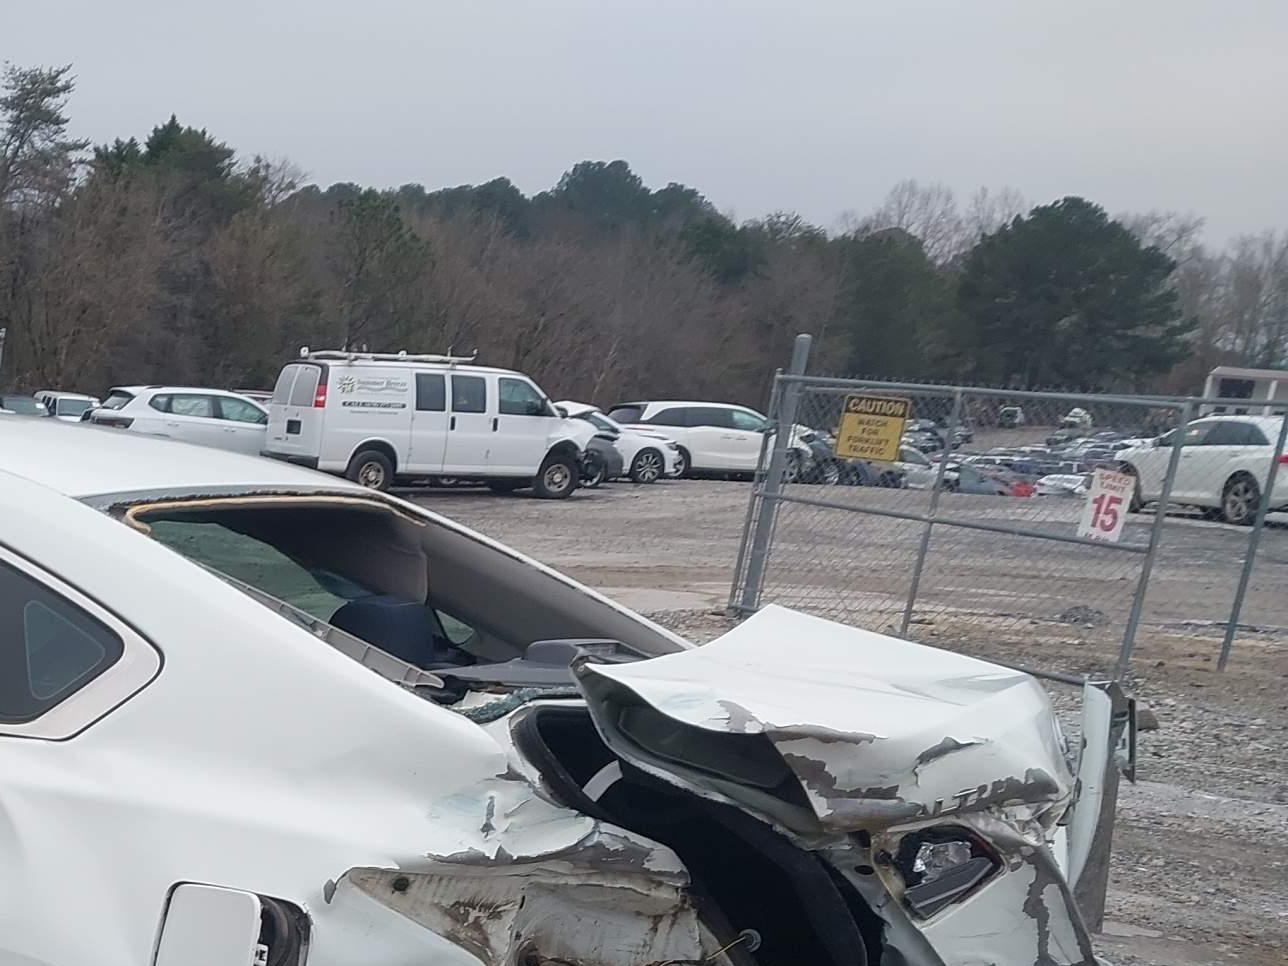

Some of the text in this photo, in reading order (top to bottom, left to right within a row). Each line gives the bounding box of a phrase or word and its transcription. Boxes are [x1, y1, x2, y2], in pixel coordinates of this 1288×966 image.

[848, 398, 905, 416] CAUTION
[857, 419, 888, 428] WATCH
[861, 427, 880, 436] FOR
[847, 435, 890, 446] FORKLIFT
[848, 444, 886, 456] TRAFFIC
[1099, 472, 1131, 486] SPEED
[1099, 481, 1126, 494] LIMIT
[1090, 493, 1124, 532] 15
